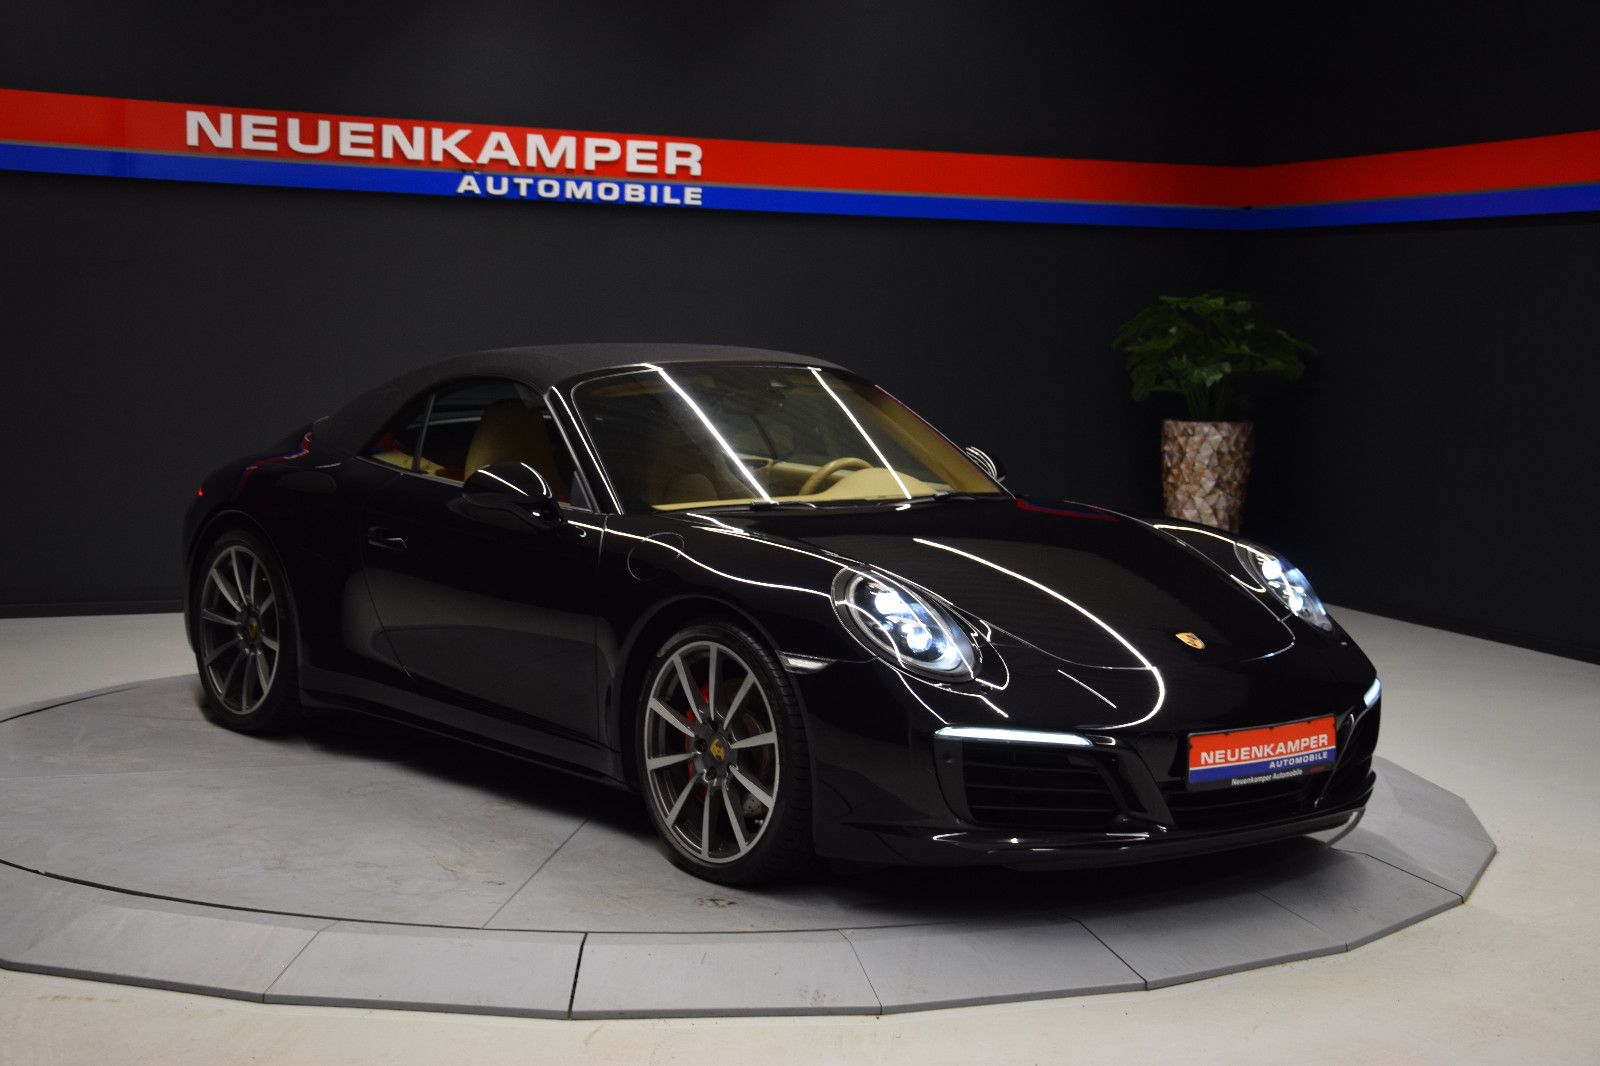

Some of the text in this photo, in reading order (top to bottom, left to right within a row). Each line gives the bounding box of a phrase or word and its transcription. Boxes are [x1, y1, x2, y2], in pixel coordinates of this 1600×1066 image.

[185, 110, 703, 176] NEUENKAMPER
[456, 175, 703, 207] AUTOMOBILE
[1200, 734, 1329, 765] NEUENKAMPER
[1269, 751, 1328, 769] AUTOMOBILE
[1231, 768, 1303, 786] Neuenkamper Automobile
